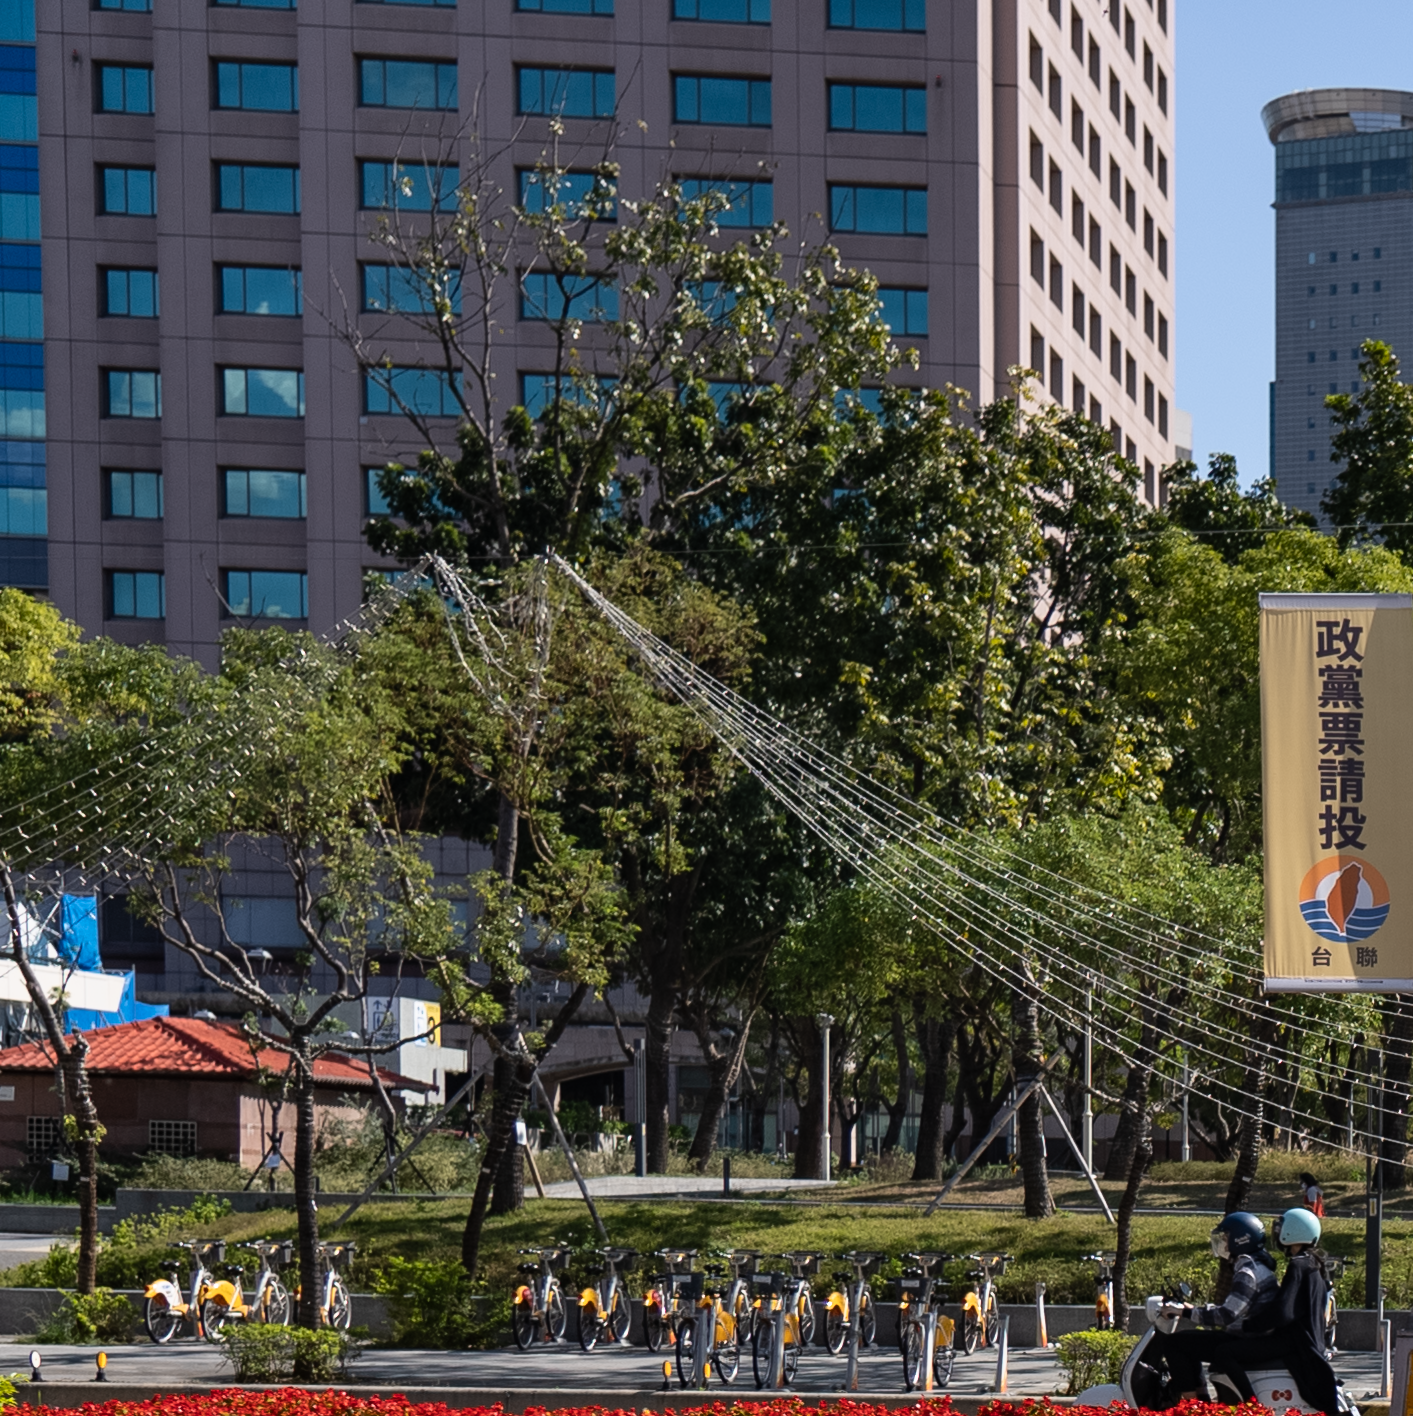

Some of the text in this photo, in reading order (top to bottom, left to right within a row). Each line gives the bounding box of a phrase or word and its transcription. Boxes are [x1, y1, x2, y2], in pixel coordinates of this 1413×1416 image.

[1316, 618, 1367, 850] 政黨票請投
[1311, 946, 1378, 968] 台聯
